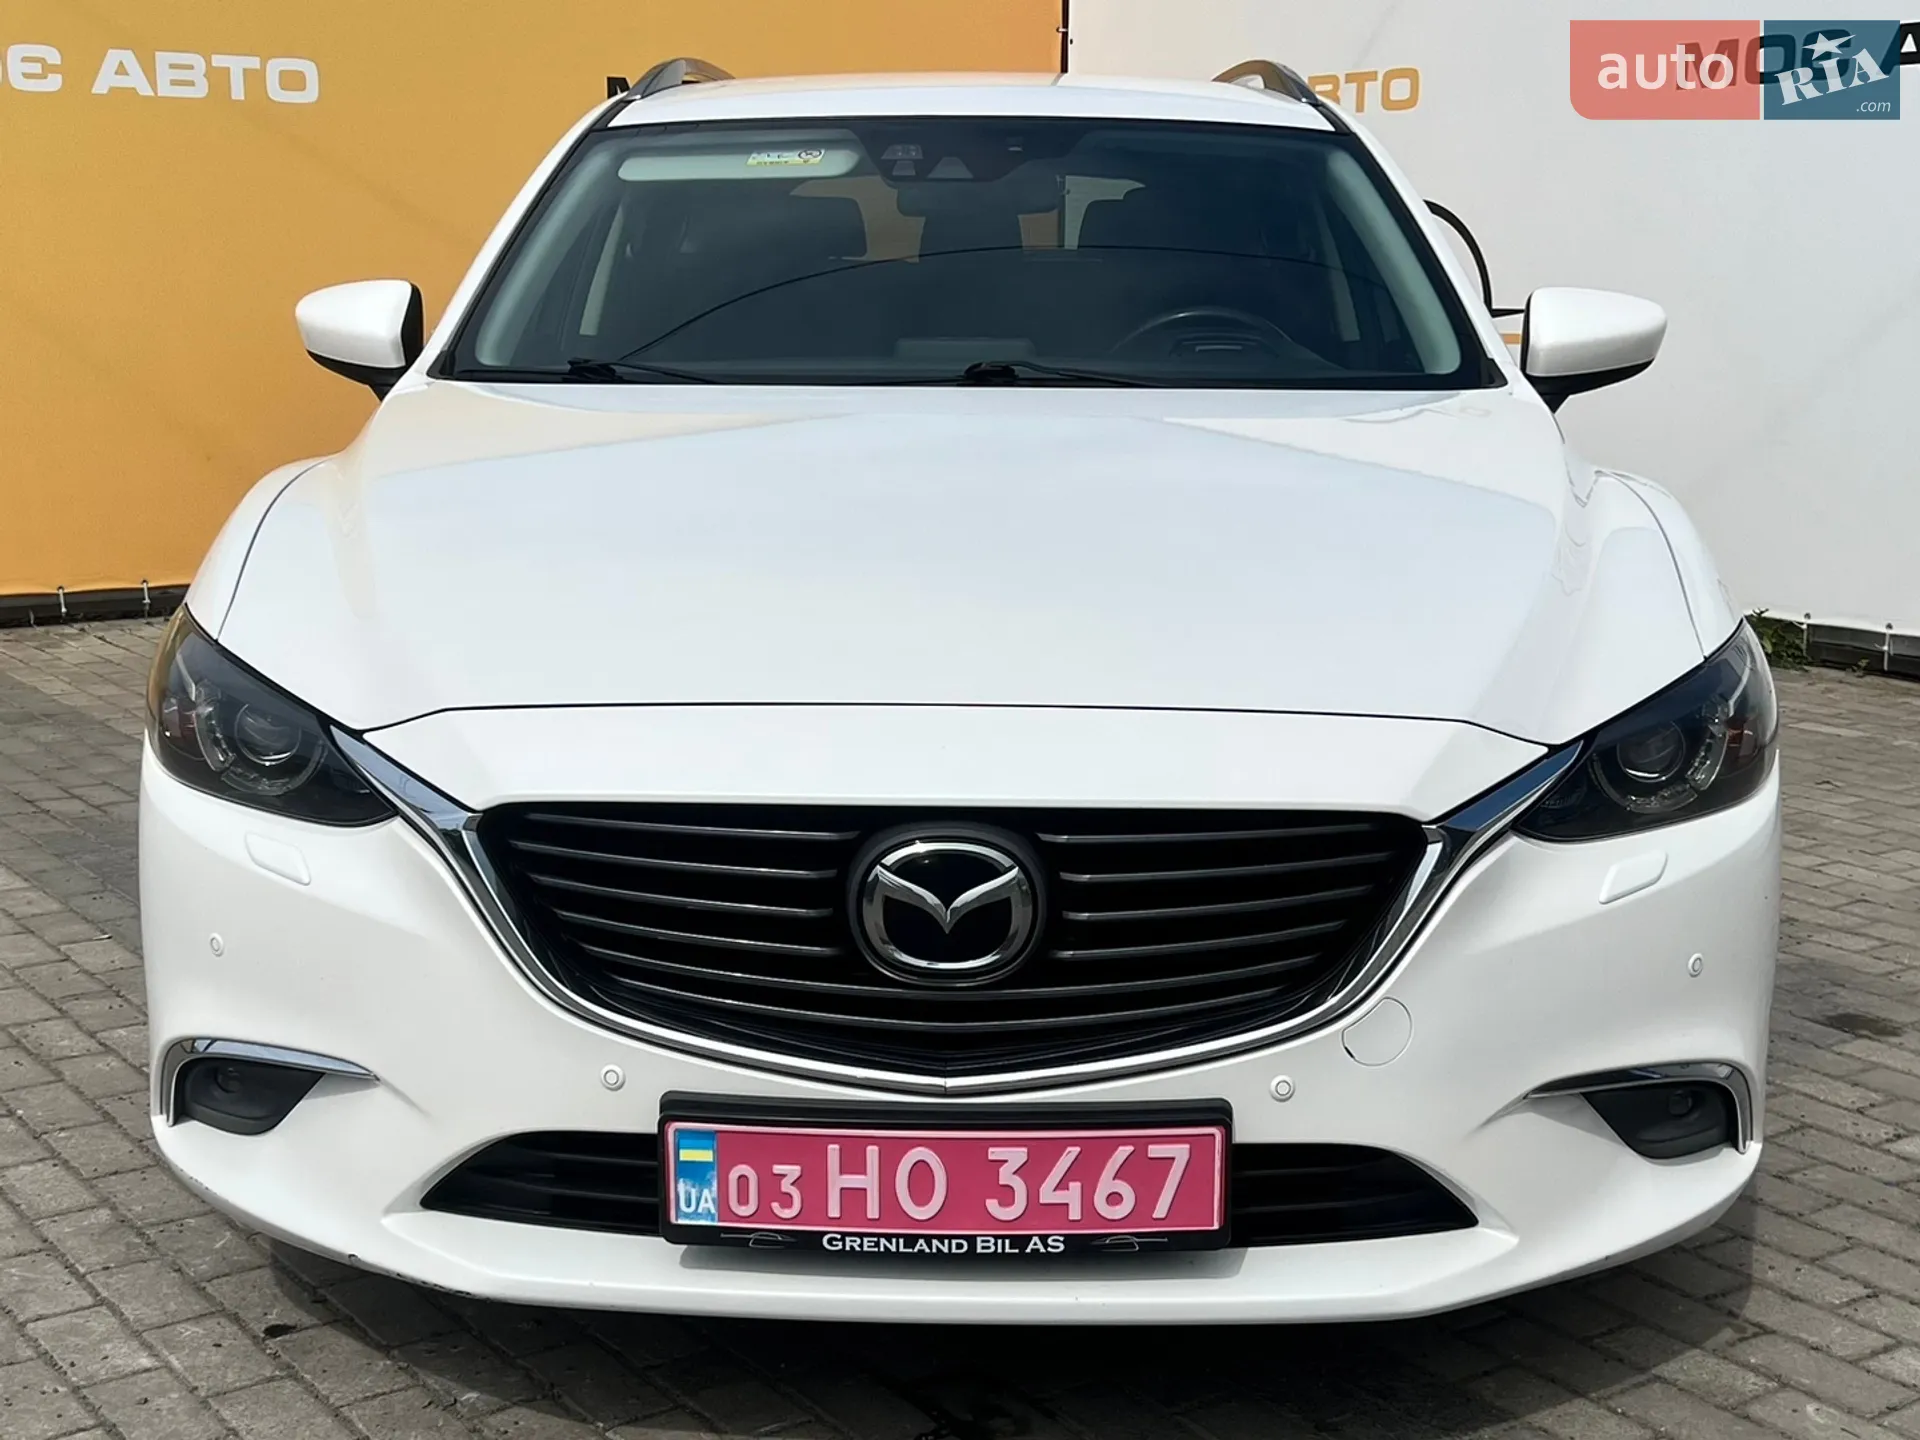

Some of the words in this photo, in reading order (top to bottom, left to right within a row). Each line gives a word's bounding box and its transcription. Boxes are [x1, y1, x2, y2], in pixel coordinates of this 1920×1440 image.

[0, 43, 62, 92] Є
[91, 48, 319, 104] АВТО
[678, 1183, 716, 1214] UA
[728, 1164, 803, 1219] 03
[827, 1143, 948, 1220] HO
[985, 1143, 1191, 1222] 3467
[1025, 1235, 1066, 1253] AS
